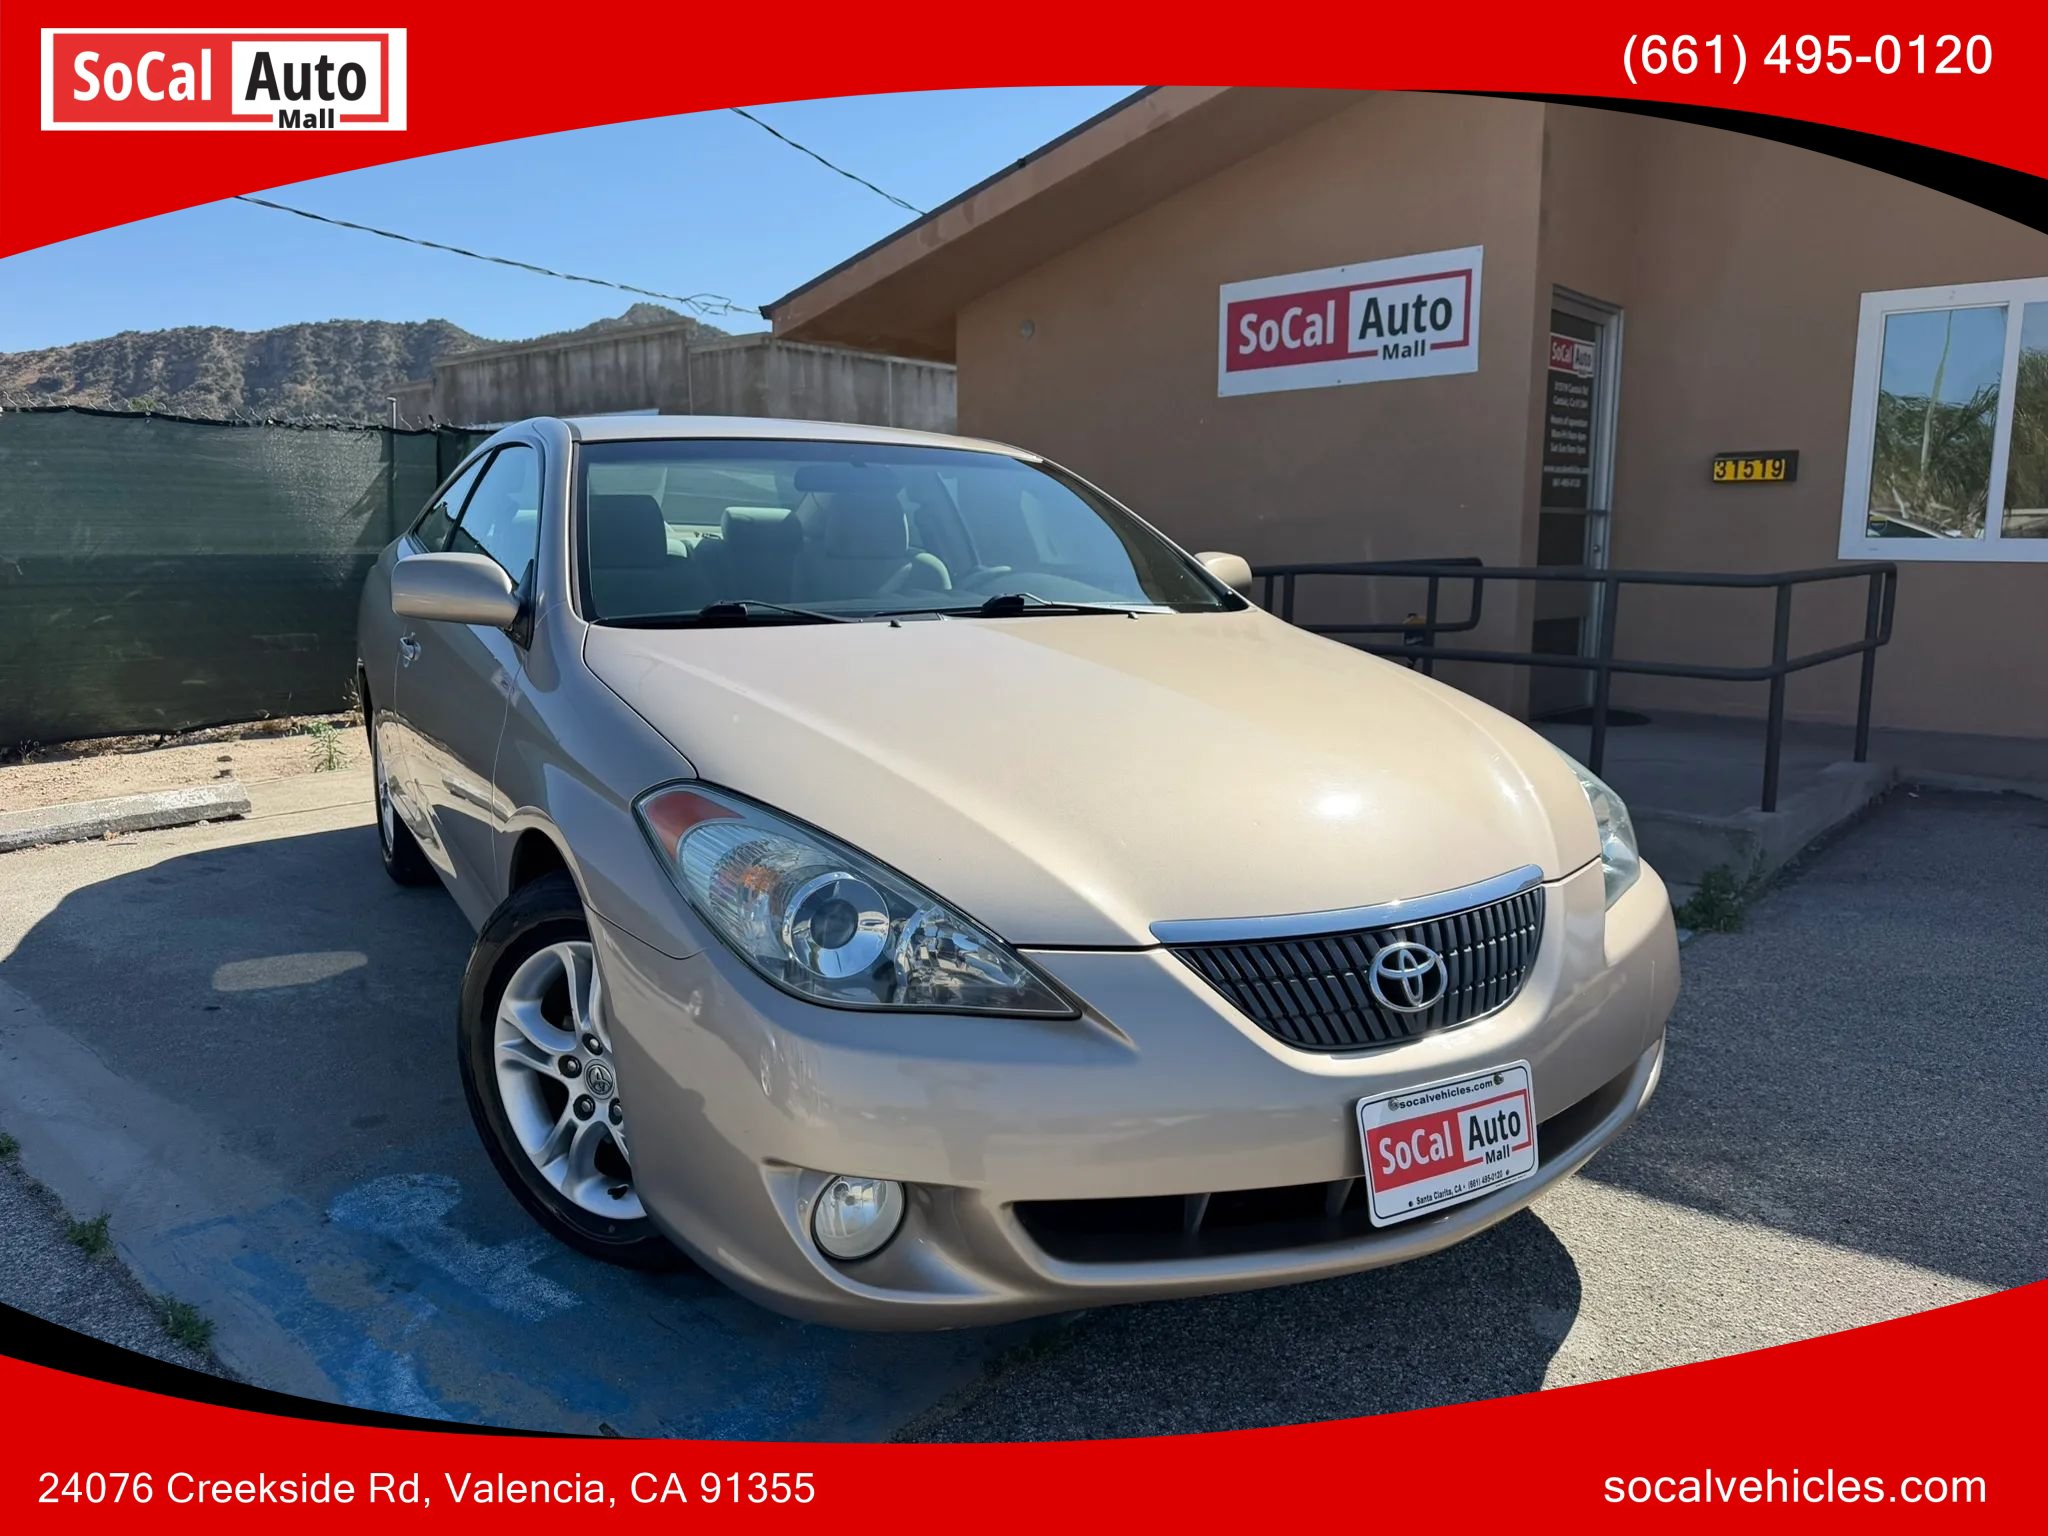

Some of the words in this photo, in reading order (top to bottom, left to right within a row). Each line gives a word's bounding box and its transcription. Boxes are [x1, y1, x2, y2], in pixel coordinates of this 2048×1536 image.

[1239, 300, 1336, 355] SoCal
[1358, 294, 1453, 340] Auto
[1382, 339, 1426, 360] Mall
[1552, 341, 1573, 364] SoCal
[1715, 459, 1783, 479] 31519
[1399, 1078, 1493, 1109] socalvehicles.com
[1379, 1120, 1454, 1175] SoCal
[1468, 1109, 1521, 1151] Auto
[1485, 1144, 1510, 1165] Mall
[1416, 1195, 1433, 1206] Santa
[1454, 1184, 1463, 1194] CA
